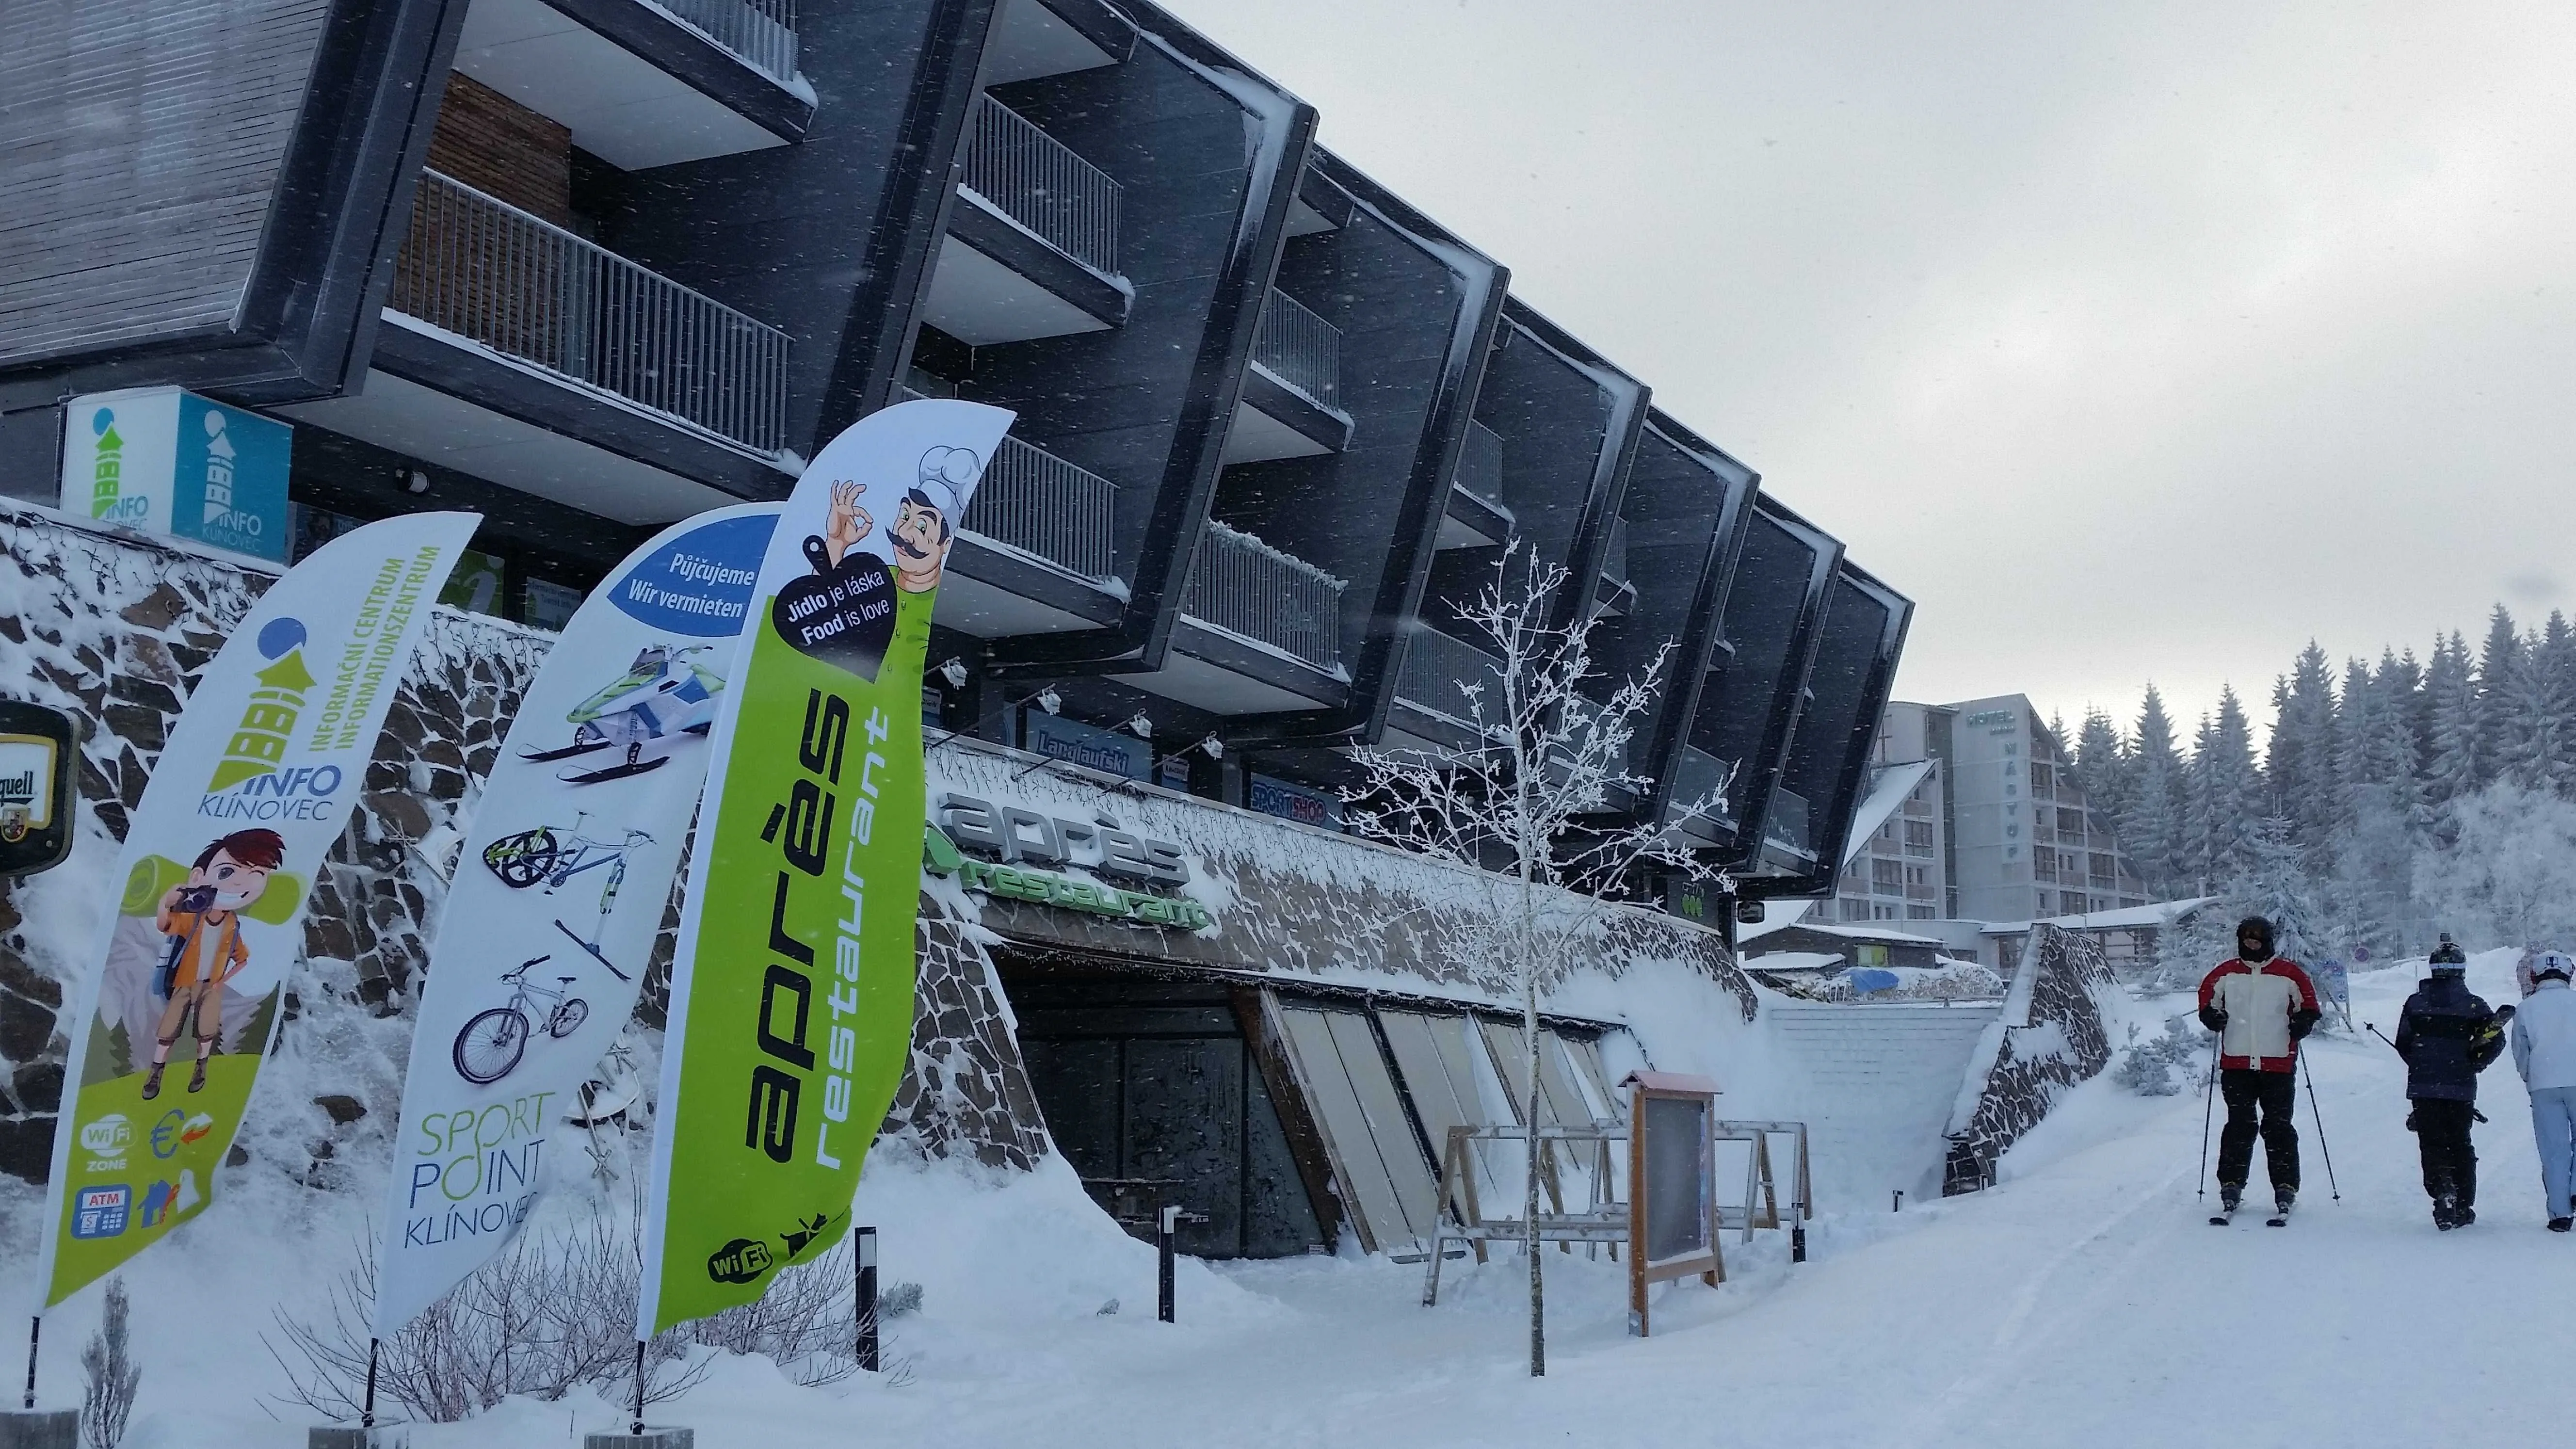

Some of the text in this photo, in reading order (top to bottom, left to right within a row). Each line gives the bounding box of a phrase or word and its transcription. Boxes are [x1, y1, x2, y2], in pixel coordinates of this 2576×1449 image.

[106, 496, 148, 519] INFO
[219, 511, 261, 535] INFO
[669, 553, 755, 586] Půjčujeme
[629, 579, 743, 618] Wir vermieten
[788, 571, 885, 622] Jídlo je láska
[801, 599, 890, 645] Food is love
[308, 558, 405, 751] INFORMAČNÍ CENTRUM
[334, 546, 441, 749] INFORMATIONSZENTRUM
[1966, 709, 2015, 727] HOTEL
[1037, 731, 1128, 773] Langlaufski
[243, 766, 341, 796] INFO
[196, 792, 333, 820] KLÍNOVEC
[940, 792, 1191, 887] après
[959, 858, 1209, 930] restaurant
[746, 688, 851, 1163] après
[816, 706, 889, 1170] restaurant
[418, 1092, 556, 1156] SPORT
[86, 1159, 128, 1172] ZONE
[410, 1139, 545, 1209] POINT
[89, 1193, 119, 1206] ATM
